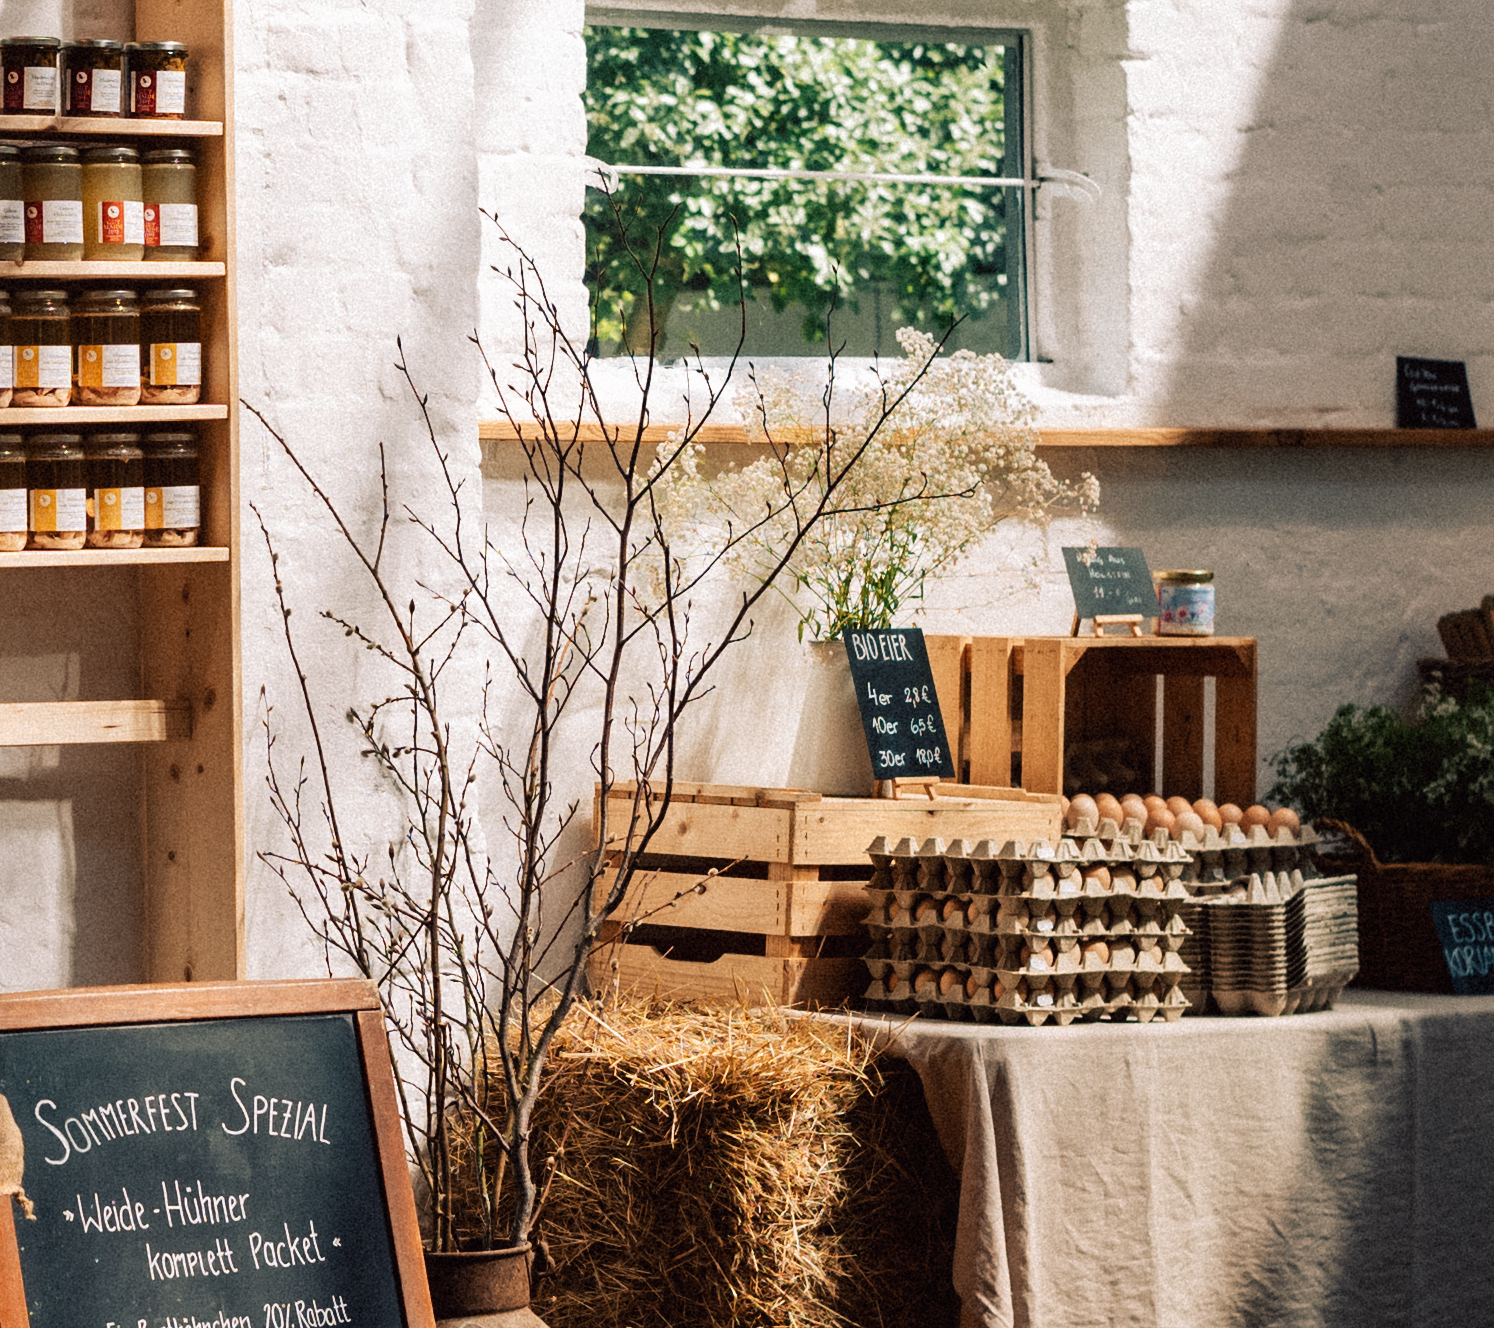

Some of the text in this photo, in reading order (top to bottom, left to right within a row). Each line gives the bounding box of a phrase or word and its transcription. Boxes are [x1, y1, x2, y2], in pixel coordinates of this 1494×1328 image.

[852, 633, 913, 661] BIO EIER
[868, 682, 931, 708] 4er 2,8€
[873, 716, 898, 734] 10er
[879, 750, 905, 767] 30er
[35, 1077, 330, 1165] SOMMERFEST SPEZIAL
[146, 1243, 238, 1281] komplett
[249, 1221, 325, 1270] Packet
[295, 1295, 351, 1328] Rabatt
